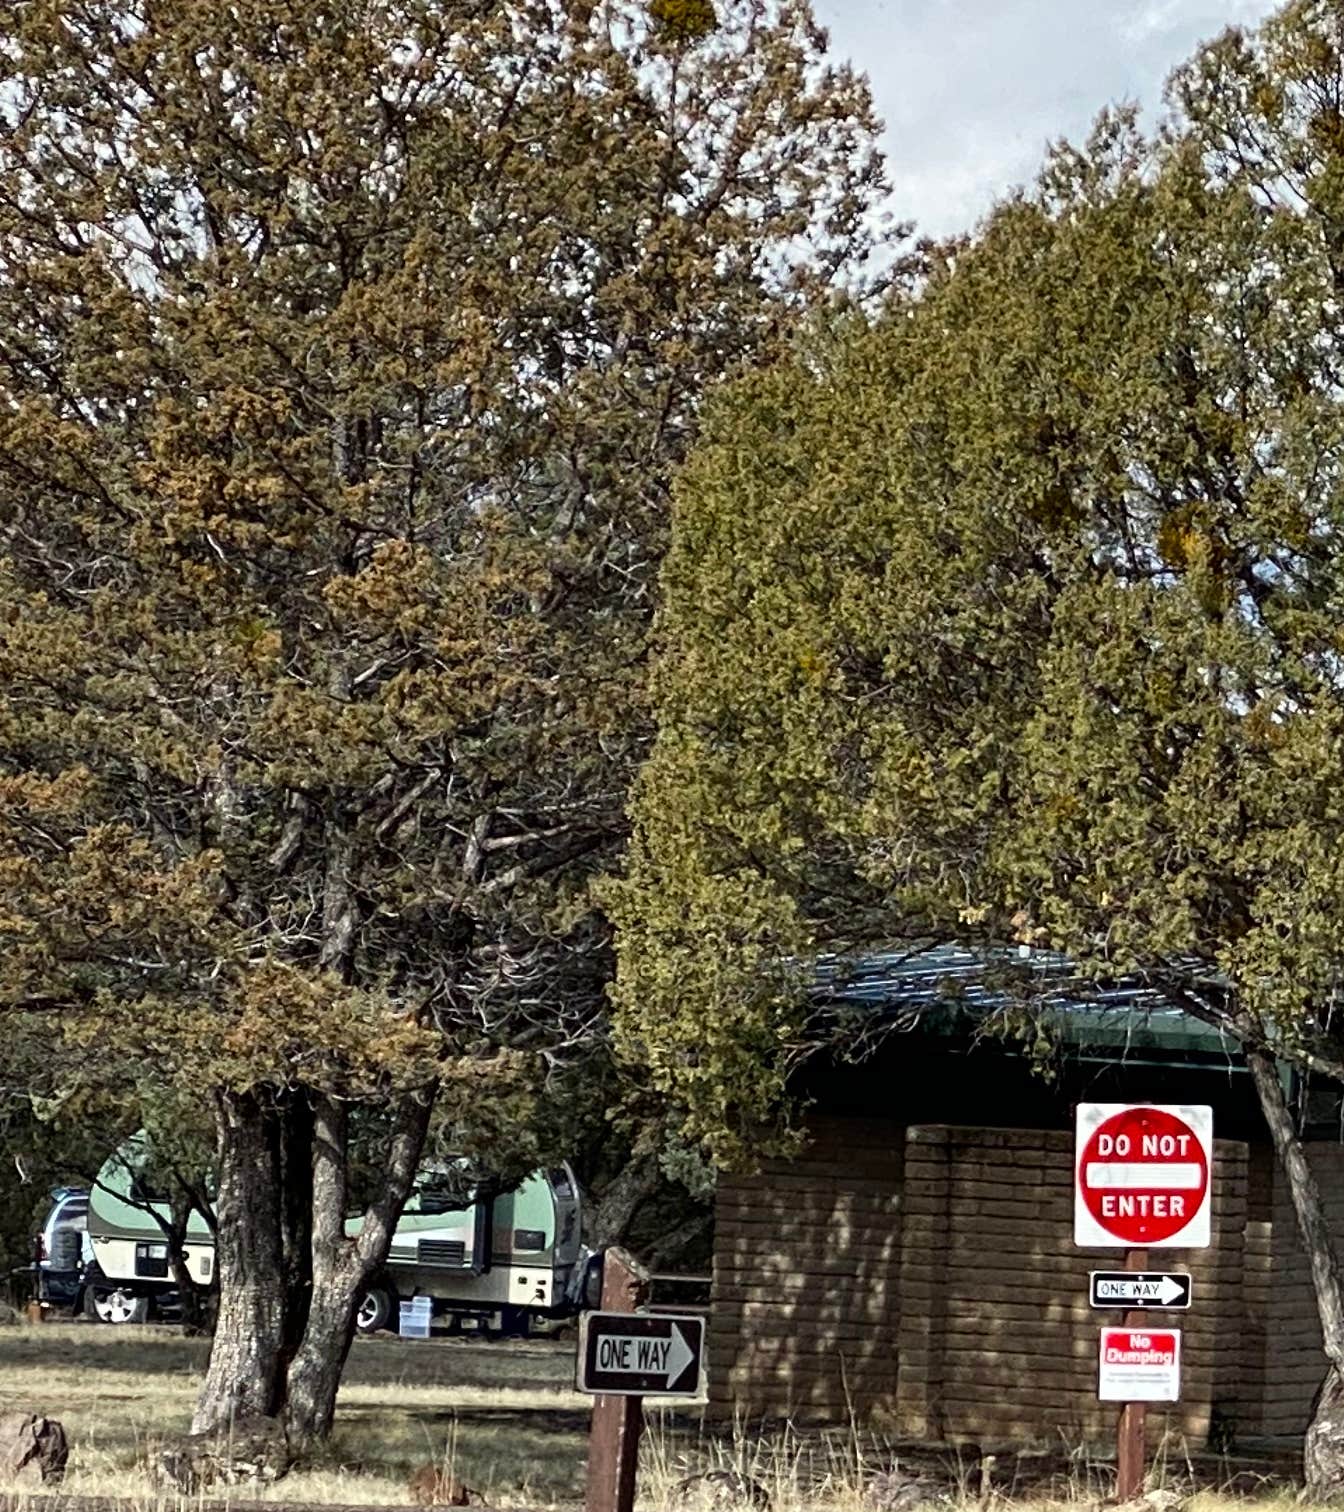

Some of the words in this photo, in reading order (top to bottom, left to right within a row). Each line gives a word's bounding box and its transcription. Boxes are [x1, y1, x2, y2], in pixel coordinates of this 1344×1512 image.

[1098, 1134, 1131, 1156] DO
[1142, 1134, 1191, 1156] NOT
[1102, 1195, 1184, 1217] ENTER
[1100, 1282, 1127, 1296] ONE
[1132, 1283, 1160, 1297] WAY
[1130, 1334, 1151, 1349] No
[600, 1339, 632, 1369] ONE
[638, 1340, 672, 1370] WAY
[1106, 1348, 1173, 1367] Dumping
